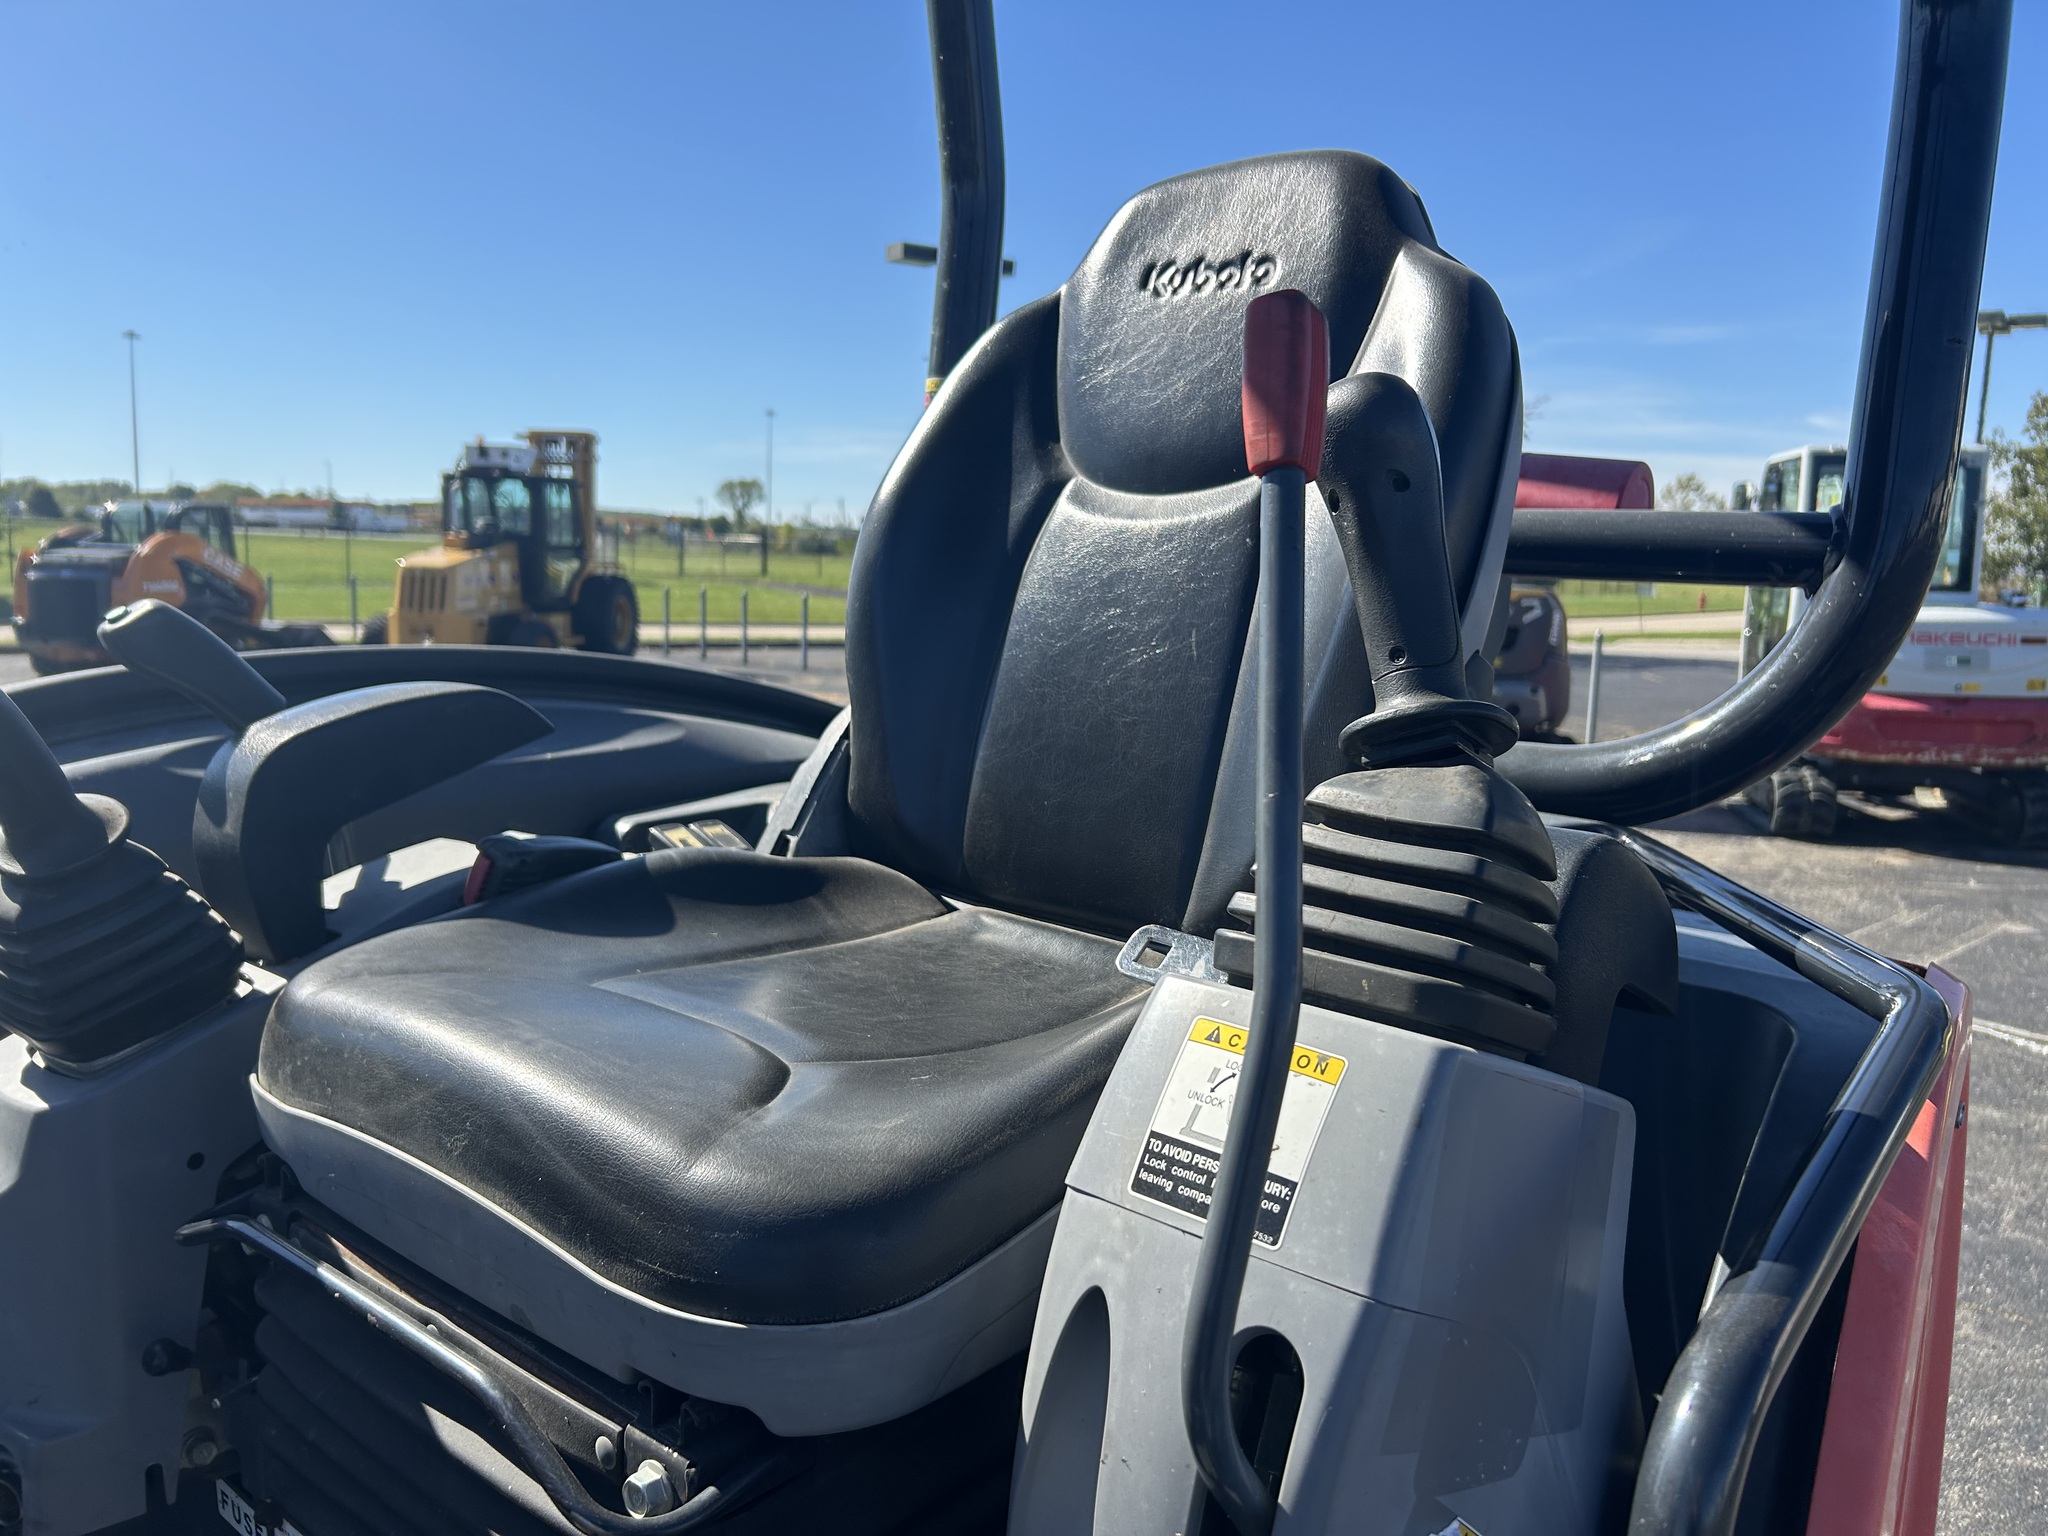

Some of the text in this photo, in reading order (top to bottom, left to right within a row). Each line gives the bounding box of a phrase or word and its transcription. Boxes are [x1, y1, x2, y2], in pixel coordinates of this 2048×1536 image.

[1226, 1059, 1243, 1072] LOC
[1187, 1089, 1226, 1109] UNLOCK
[1143, 1153, 1167, 1171] Lock
[1171, 1166, 1207, 1185] control
[1148, 1138, 1291, 1200] TO AVOID PERS URY:
[1138, 1168, 1281, 1213] leaving compa ore
[1253, 1230, 1274, 1244] 7532
